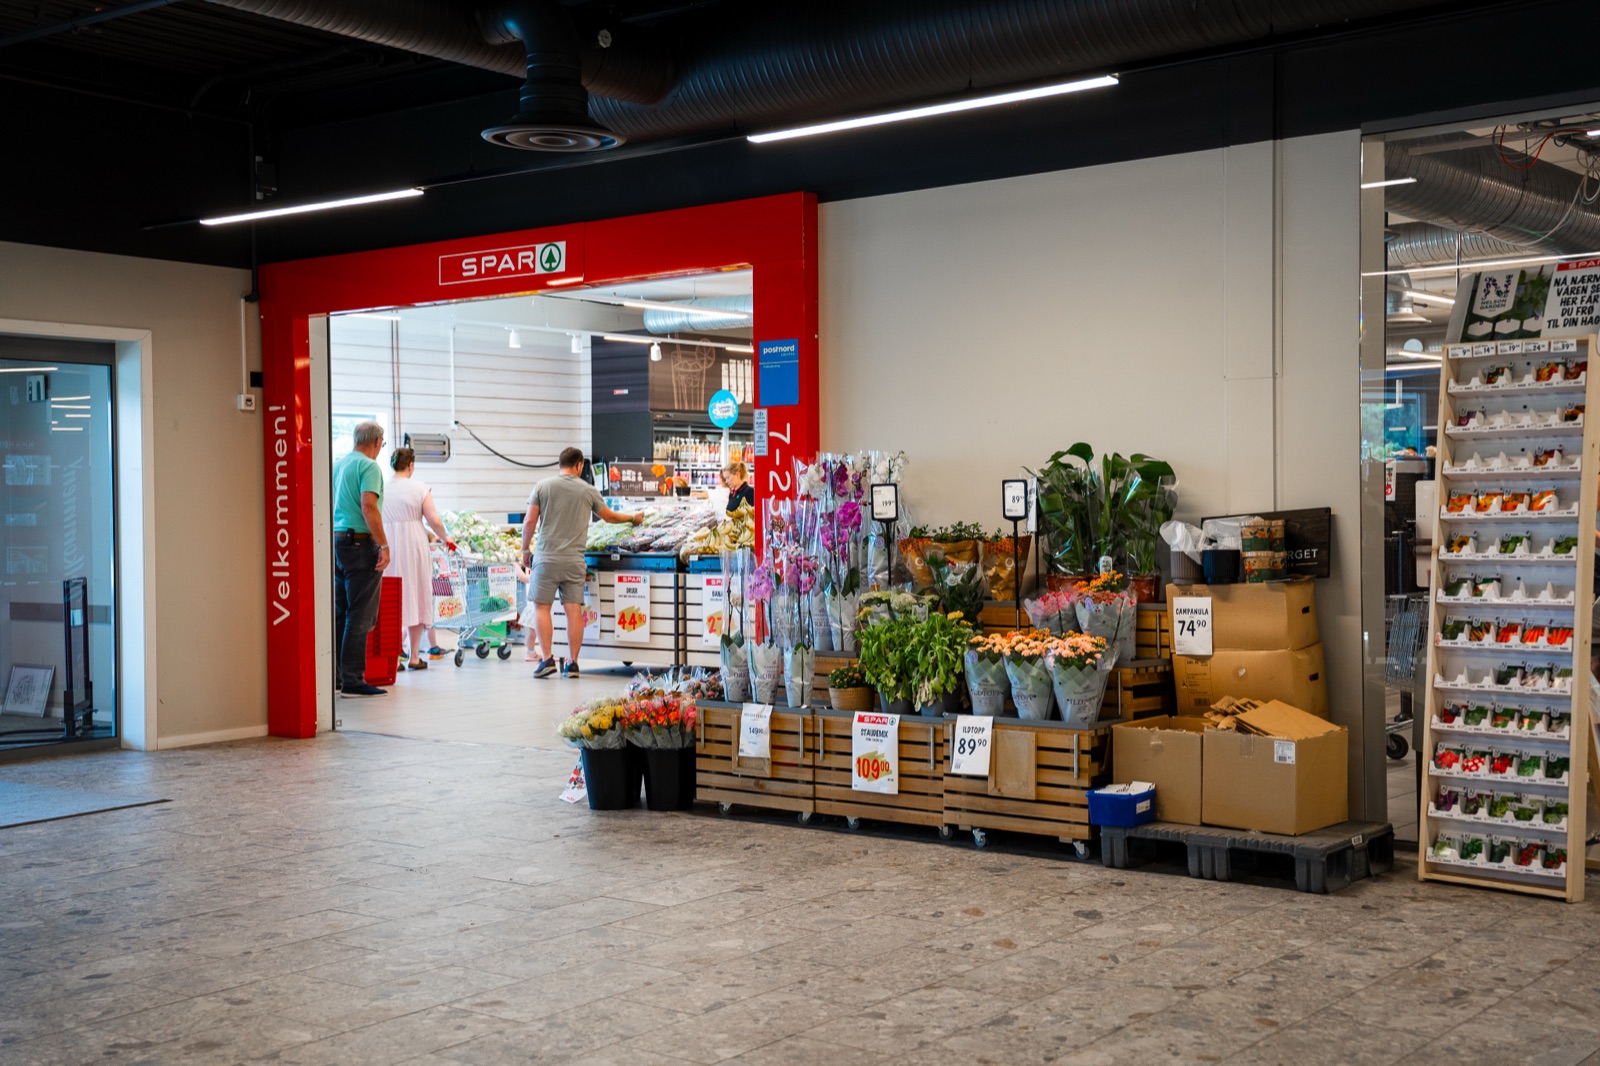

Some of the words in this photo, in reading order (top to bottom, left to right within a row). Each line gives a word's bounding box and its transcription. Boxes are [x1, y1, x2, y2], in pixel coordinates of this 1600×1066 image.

[462, 250, 534, 276] SPAR
[1554, 274, 1568, 288] NÅ
[1556, 284, 1588, 297] VÅREN
[1560, 296, 1578, 306] HER
[1580, 293, 1600, 305] FÅR
[1561, 306, 1574, 317] DU
[1576, 305, 1594, 316] FRØ
[1547, 318, 1560, 329] TIL
[1563, 316, 1578, 328] DIN
[763, 344, 795, 354] postnord
[268, 404, 291, 626] Velkommen!
[864, 716, 888, 725] SPAR
[860, 728, 889, 738] STAUDEMIX
[962, 726, 985, 734] ILDTOPP
